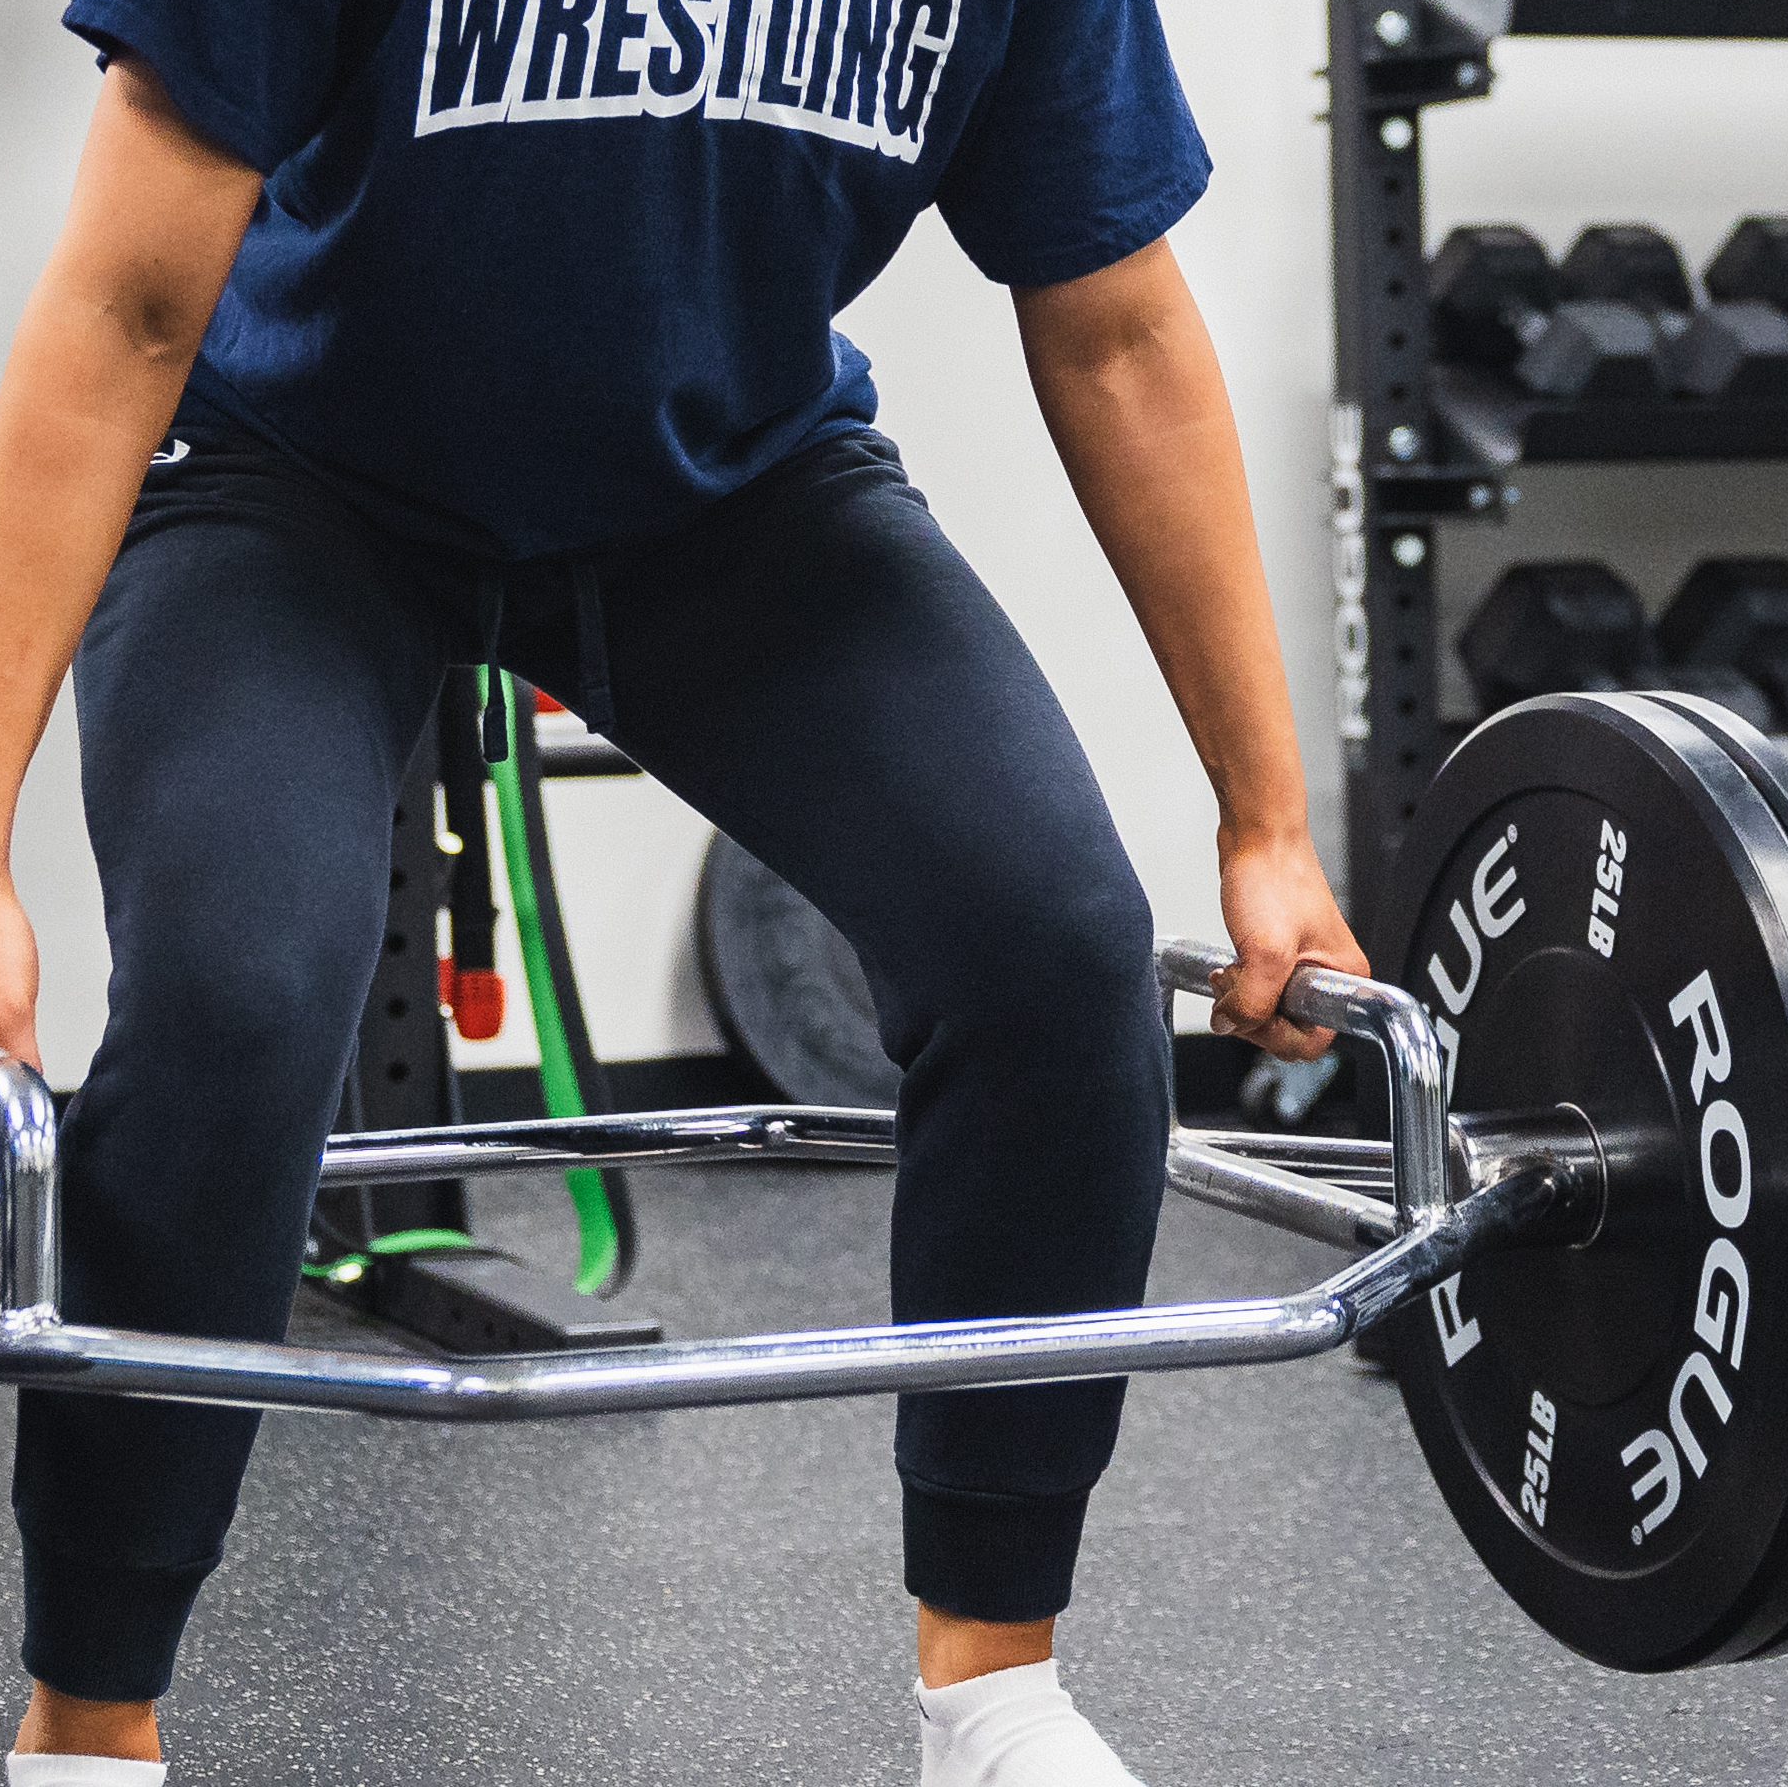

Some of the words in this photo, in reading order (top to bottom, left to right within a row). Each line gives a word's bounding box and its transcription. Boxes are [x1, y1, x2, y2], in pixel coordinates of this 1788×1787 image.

[1587, 819, 1628, 959] 25LB
[1620, 969, 1751, 1537] ROGUE
[1517, 1388, 1558, 1528] 25LB
